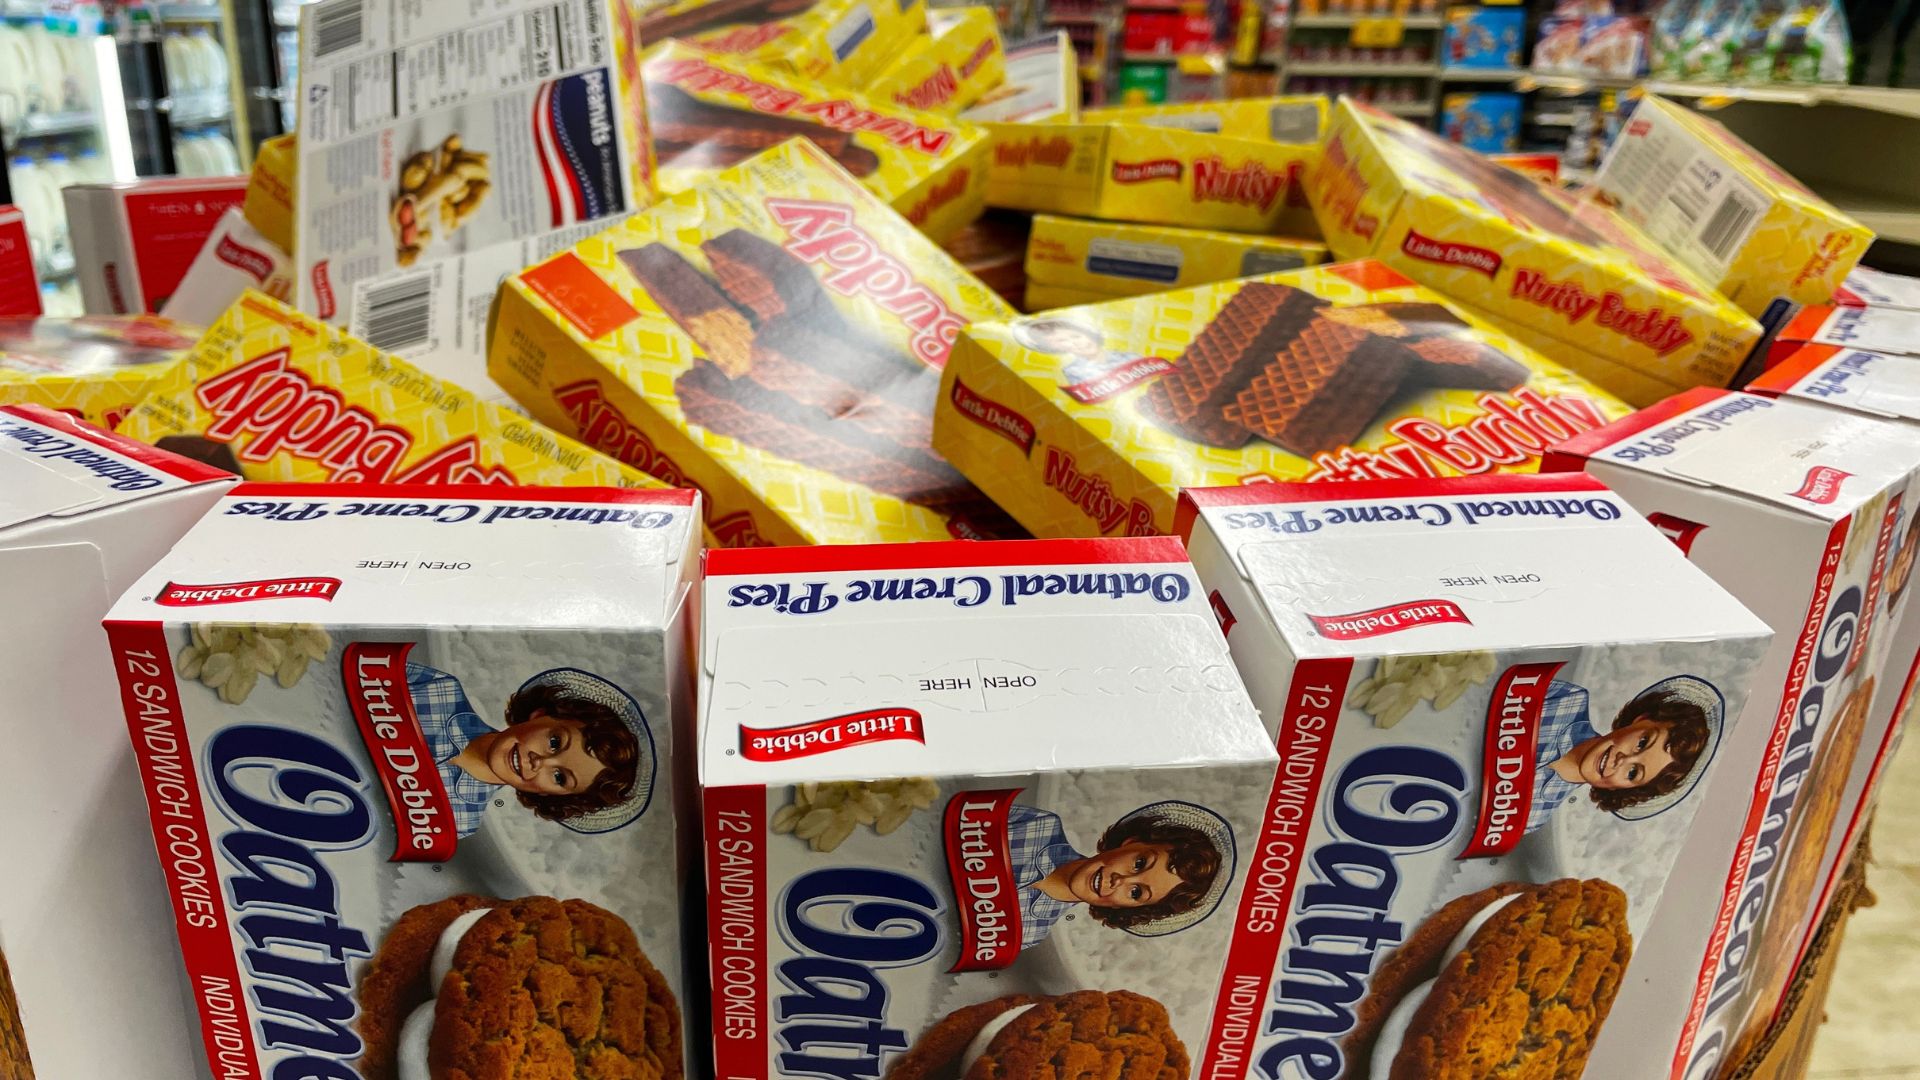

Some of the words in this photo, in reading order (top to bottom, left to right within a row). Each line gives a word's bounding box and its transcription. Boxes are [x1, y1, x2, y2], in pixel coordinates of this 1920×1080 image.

[582, 72, 612, 147] peanuts
[1191, 156, 1288, 216] Nutty
[1406, 237, 1446, 263] Little
[1446, 245, 1498, 274] Debbie
[764, 196, 972, 371] Buddy
[1508, 266, 1600, 325] Nutty
[1599, 290, 1695, 359] Buddy
[1072, 376, 1118, 402] Little
[1118, 359, 1170, 386] Debbie
[196, 345, 414, 484] Buddy
[953, 387, 986, 420] Little
[986, 407, 1029, 445] Debbie
[1387, 383, 1612, 479] Buddy
[74, 450, 164, 492] Oatmeal
[1043, 445, 1130, 535] Nutty
[224, 500, 330, 523] Pies
[336, 500, 475, 524] Creme
[481, 501, 675, 529] Oatmeal
[1225, 508, 1324, 536] Pies
[1327, 504, 1452, 527] Creme
[1452, 499, 1624, 527] Oatmeal
[356, 559, 408, 570] HERE
[418, 560, 472, 571] OPEN
[1826, 541, 1842, 567] 12
[170, 582, 264, 604] Debbie
[264, 577, 335, 599] Little
[847, 574, 994, 608] Creme
[1000, 570, 1192, 607] Oatmeal
[1438, 577, 1488, 589] HERE
[1494, 573, 1542, 585] OPEN
[727, 580, 839, 617] Pies
[1404, 602, 1460, 626] Little
[1325, 608, 1405, 636] Debbie
[1791, 574, 1833, 692] SANDWICH
[125, 648, 160, 676] 12
[919, 677, 972, 691] HERE
[983, 675, 1038, 689] OPEN
[1299, 683, 1333, 707] 12
[845, 713, 916, 738] Little
[1497, 672, 1541, 752] Little
[133, 681, 194, 820] SANDWICH
[355, 653, 402, 741] Little
[383, 745, 435, 852] Debbie
[752, 720, 845, 752] Debbie
[1759, 696, 1797, 793] COOKIES
[1270, 710, 1327, 836] SANDWICH
[1484, 754, 1524, 850] Debbie
[716, 807, 752, 835] 12
[958, 799, 998, 872] Little
[166, 824, 218, 929] COOKIES
[718, 838, 756, 949] SANDWICH
[1245, 839, 1296, 936] COOKIES
[1708, 834, 1756, 962] INDIVIDUALLY
[967, 874, 1004, 962] Debbie
[718, 953, 758, 1042] COOKIES
[199, 974, 250, 1080] INDIVIDUA
